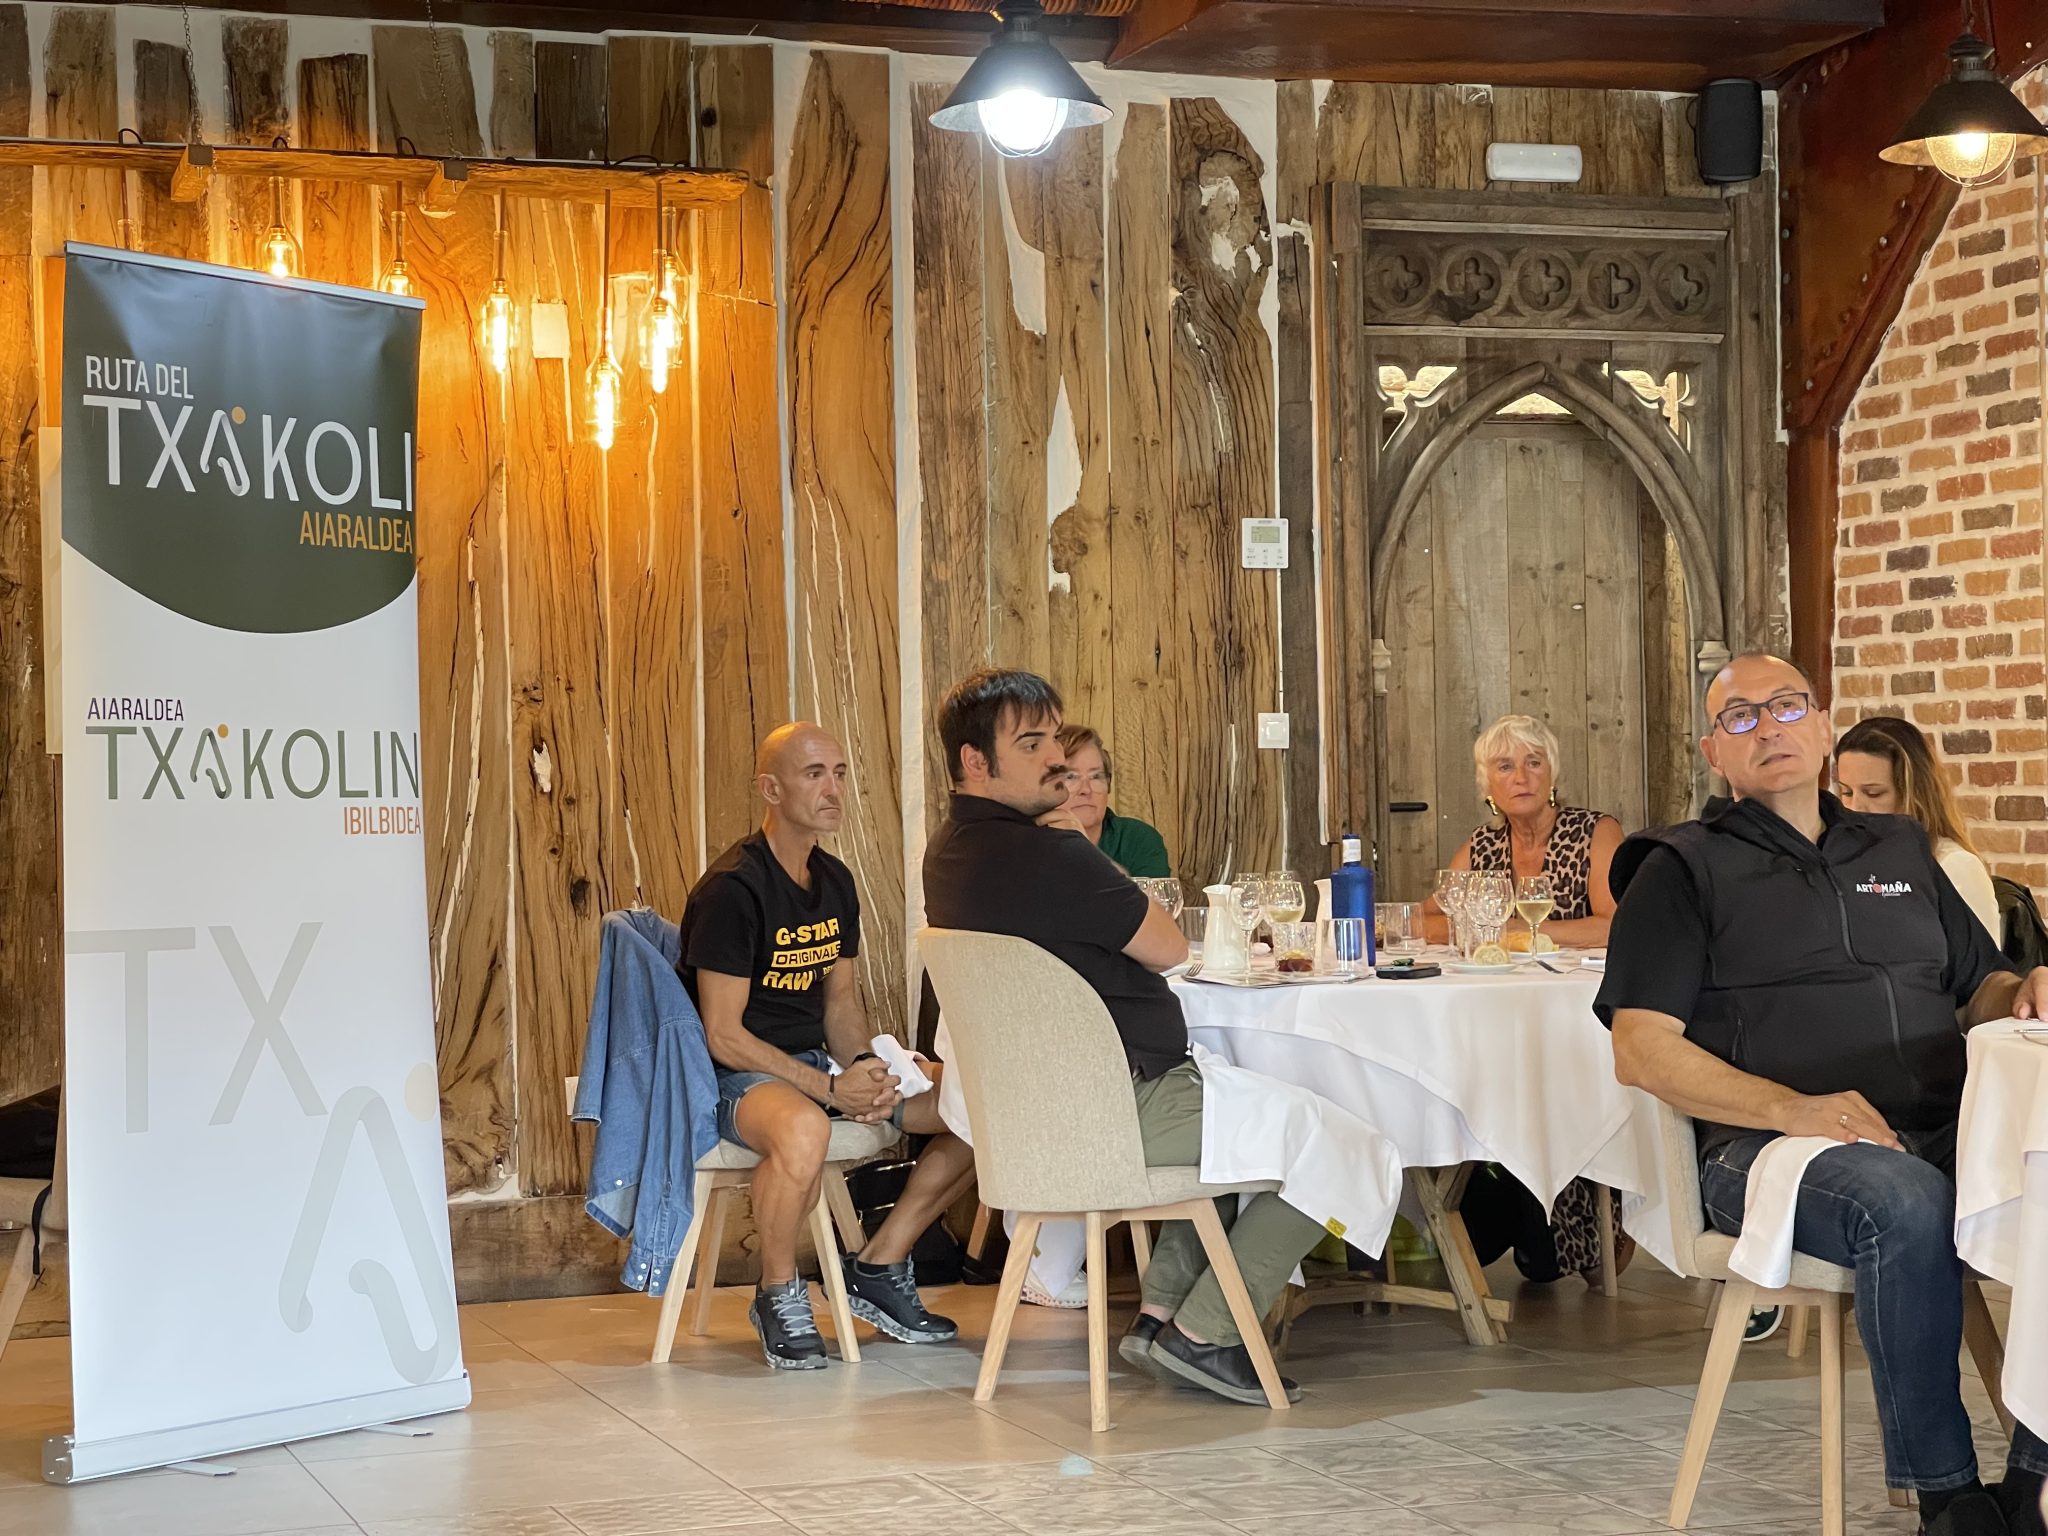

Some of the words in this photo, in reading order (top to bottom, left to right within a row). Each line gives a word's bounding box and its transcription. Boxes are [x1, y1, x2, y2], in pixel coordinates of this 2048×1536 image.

[85, 355, 150, 393] RUTA
[156, 363, 194, 400] DEL
[300, 510, 413, 554] AIARALDEA
[87, 697, 185, 722] AIARALDEA
[343, 806, 421, 834] IBILBIDEA
[1856, 881, 1912, 893] ARTOMAÑA
[775, 917, 840, 945] G-STAR
[762, 970, 814, 991] RAW
